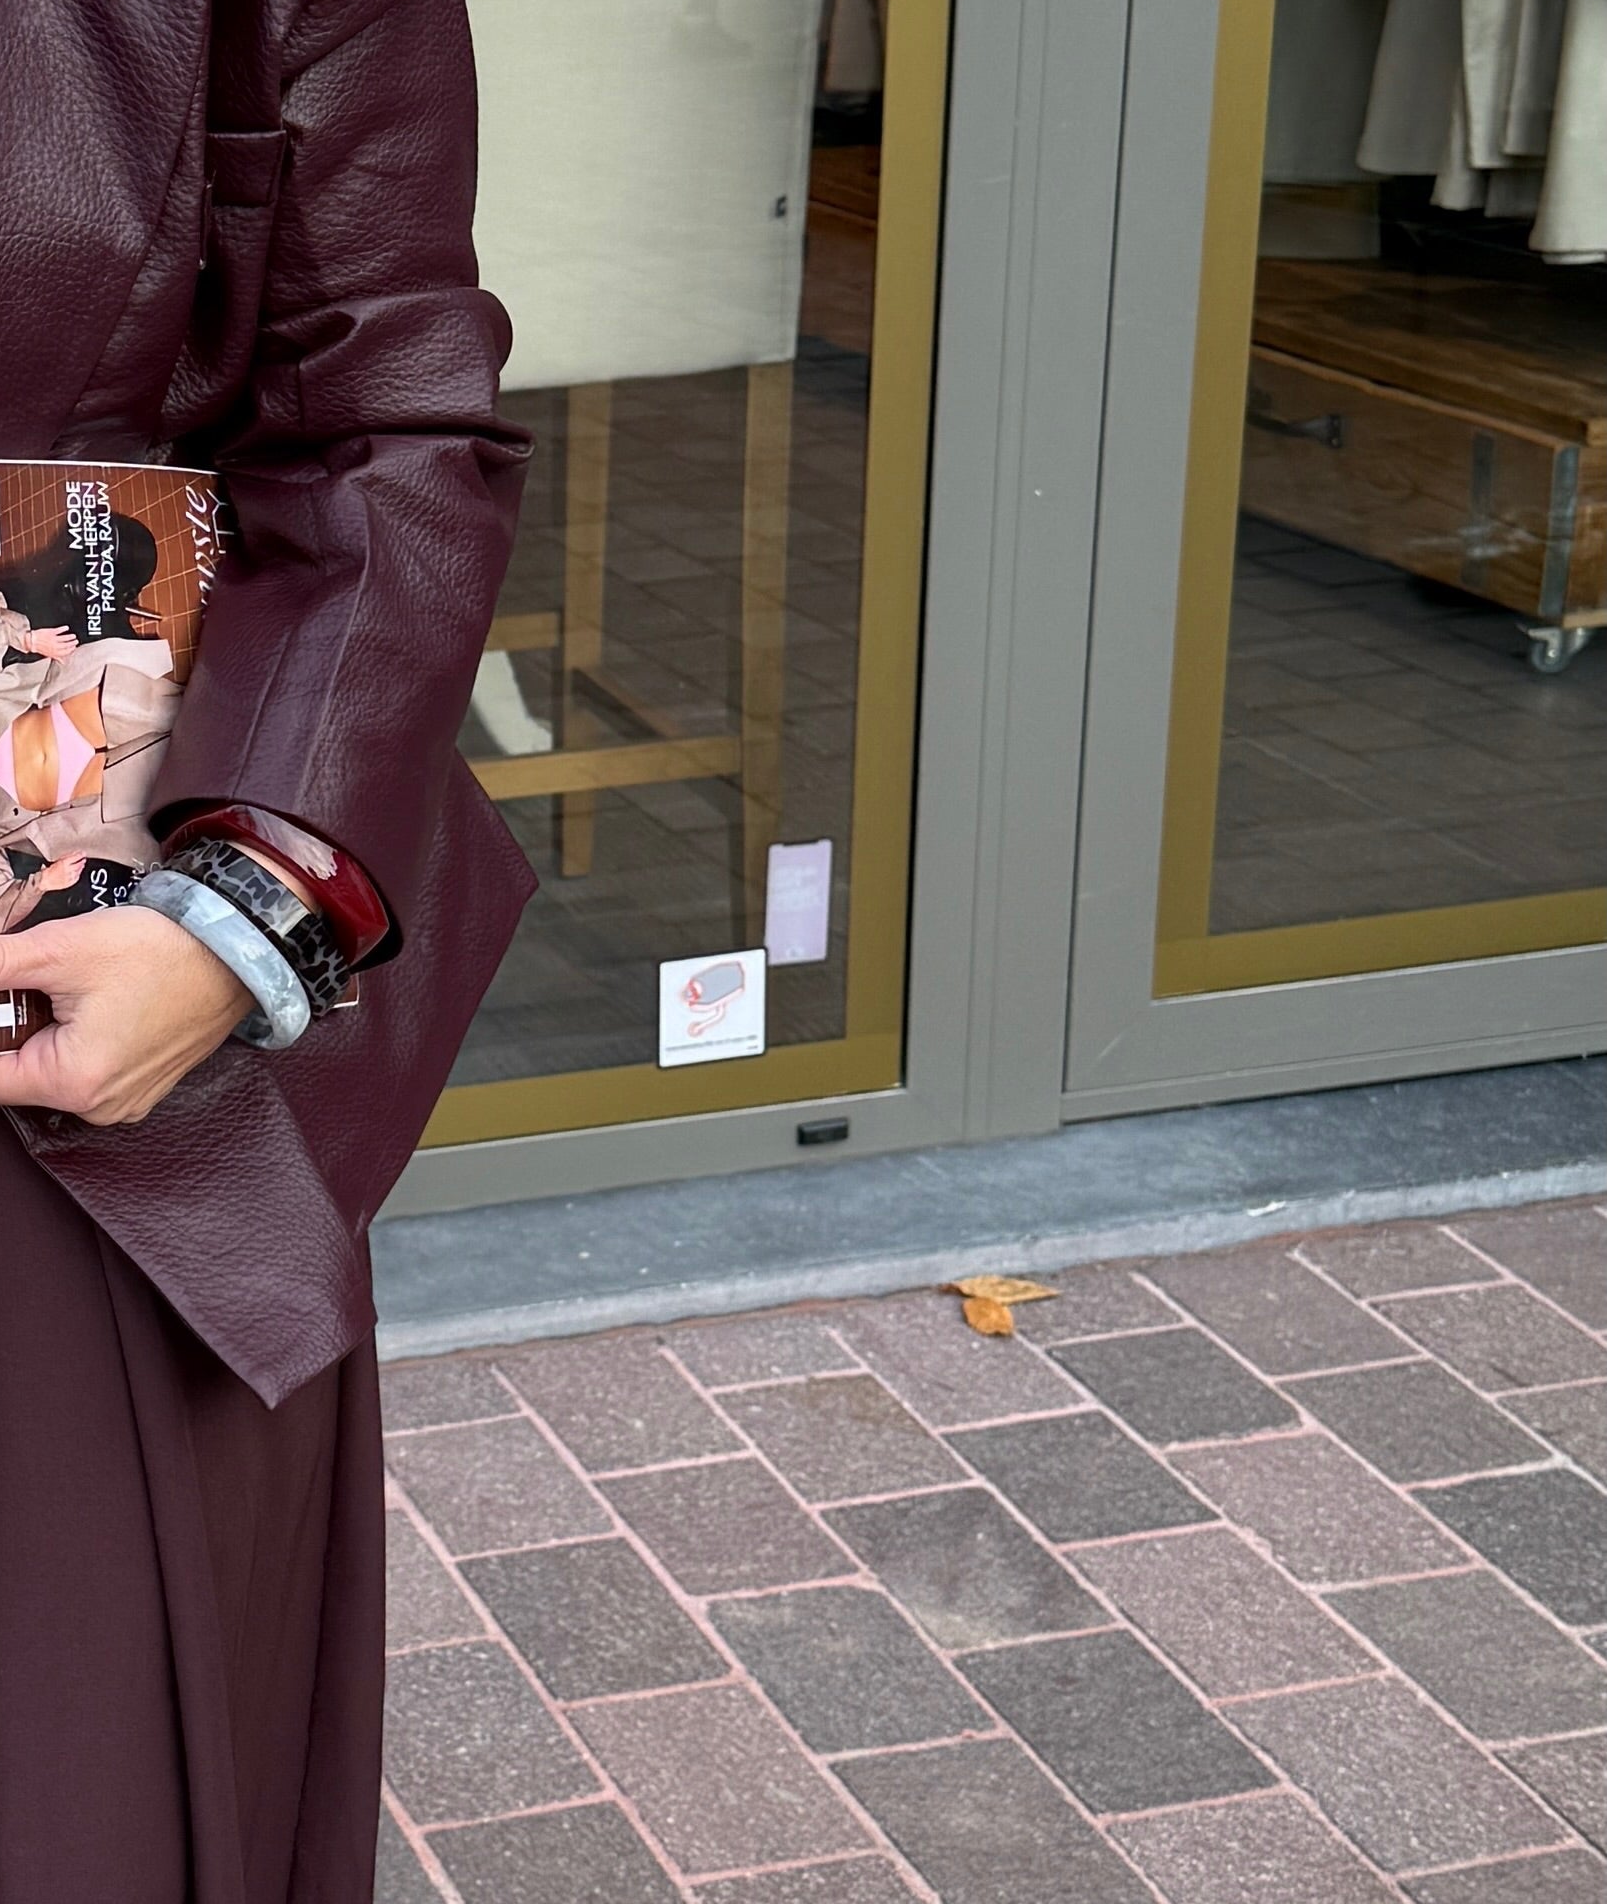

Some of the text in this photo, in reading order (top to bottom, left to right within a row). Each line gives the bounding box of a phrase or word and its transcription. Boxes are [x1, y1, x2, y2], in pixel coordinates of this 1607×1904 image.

[66, 481, 84, 550] MODE
[96, 481, 113, 542] RAUW
[82, 482, 102, 636] IRIS VAN HERPEN
